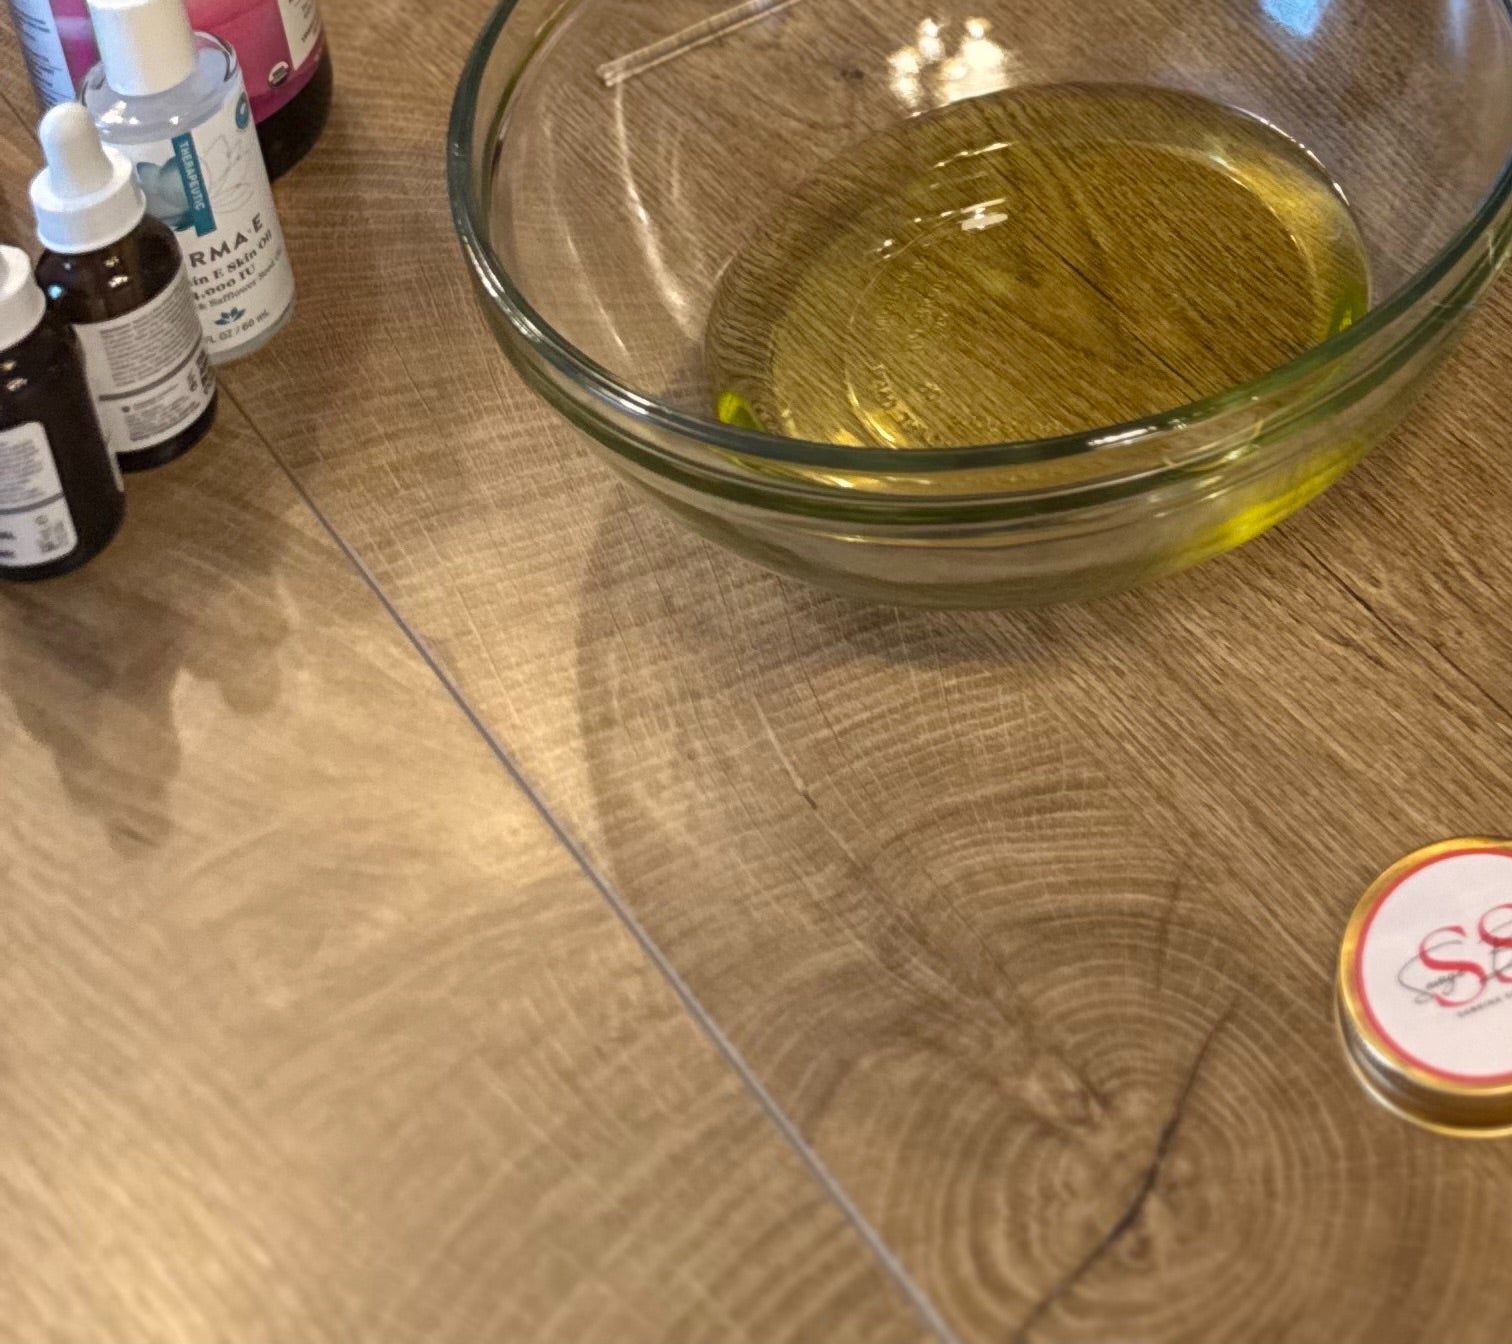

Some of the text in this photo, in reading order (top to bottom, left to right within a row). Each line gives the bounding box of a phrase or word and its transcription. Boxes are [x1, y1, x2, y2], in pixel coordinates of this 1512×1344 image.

[179, 140, 206, 211] THERAPEUTIC
[227, 249, 257, 273] Skin
[258, 229, 272, 250] Oil
[239, 264, 255, 280] IU
